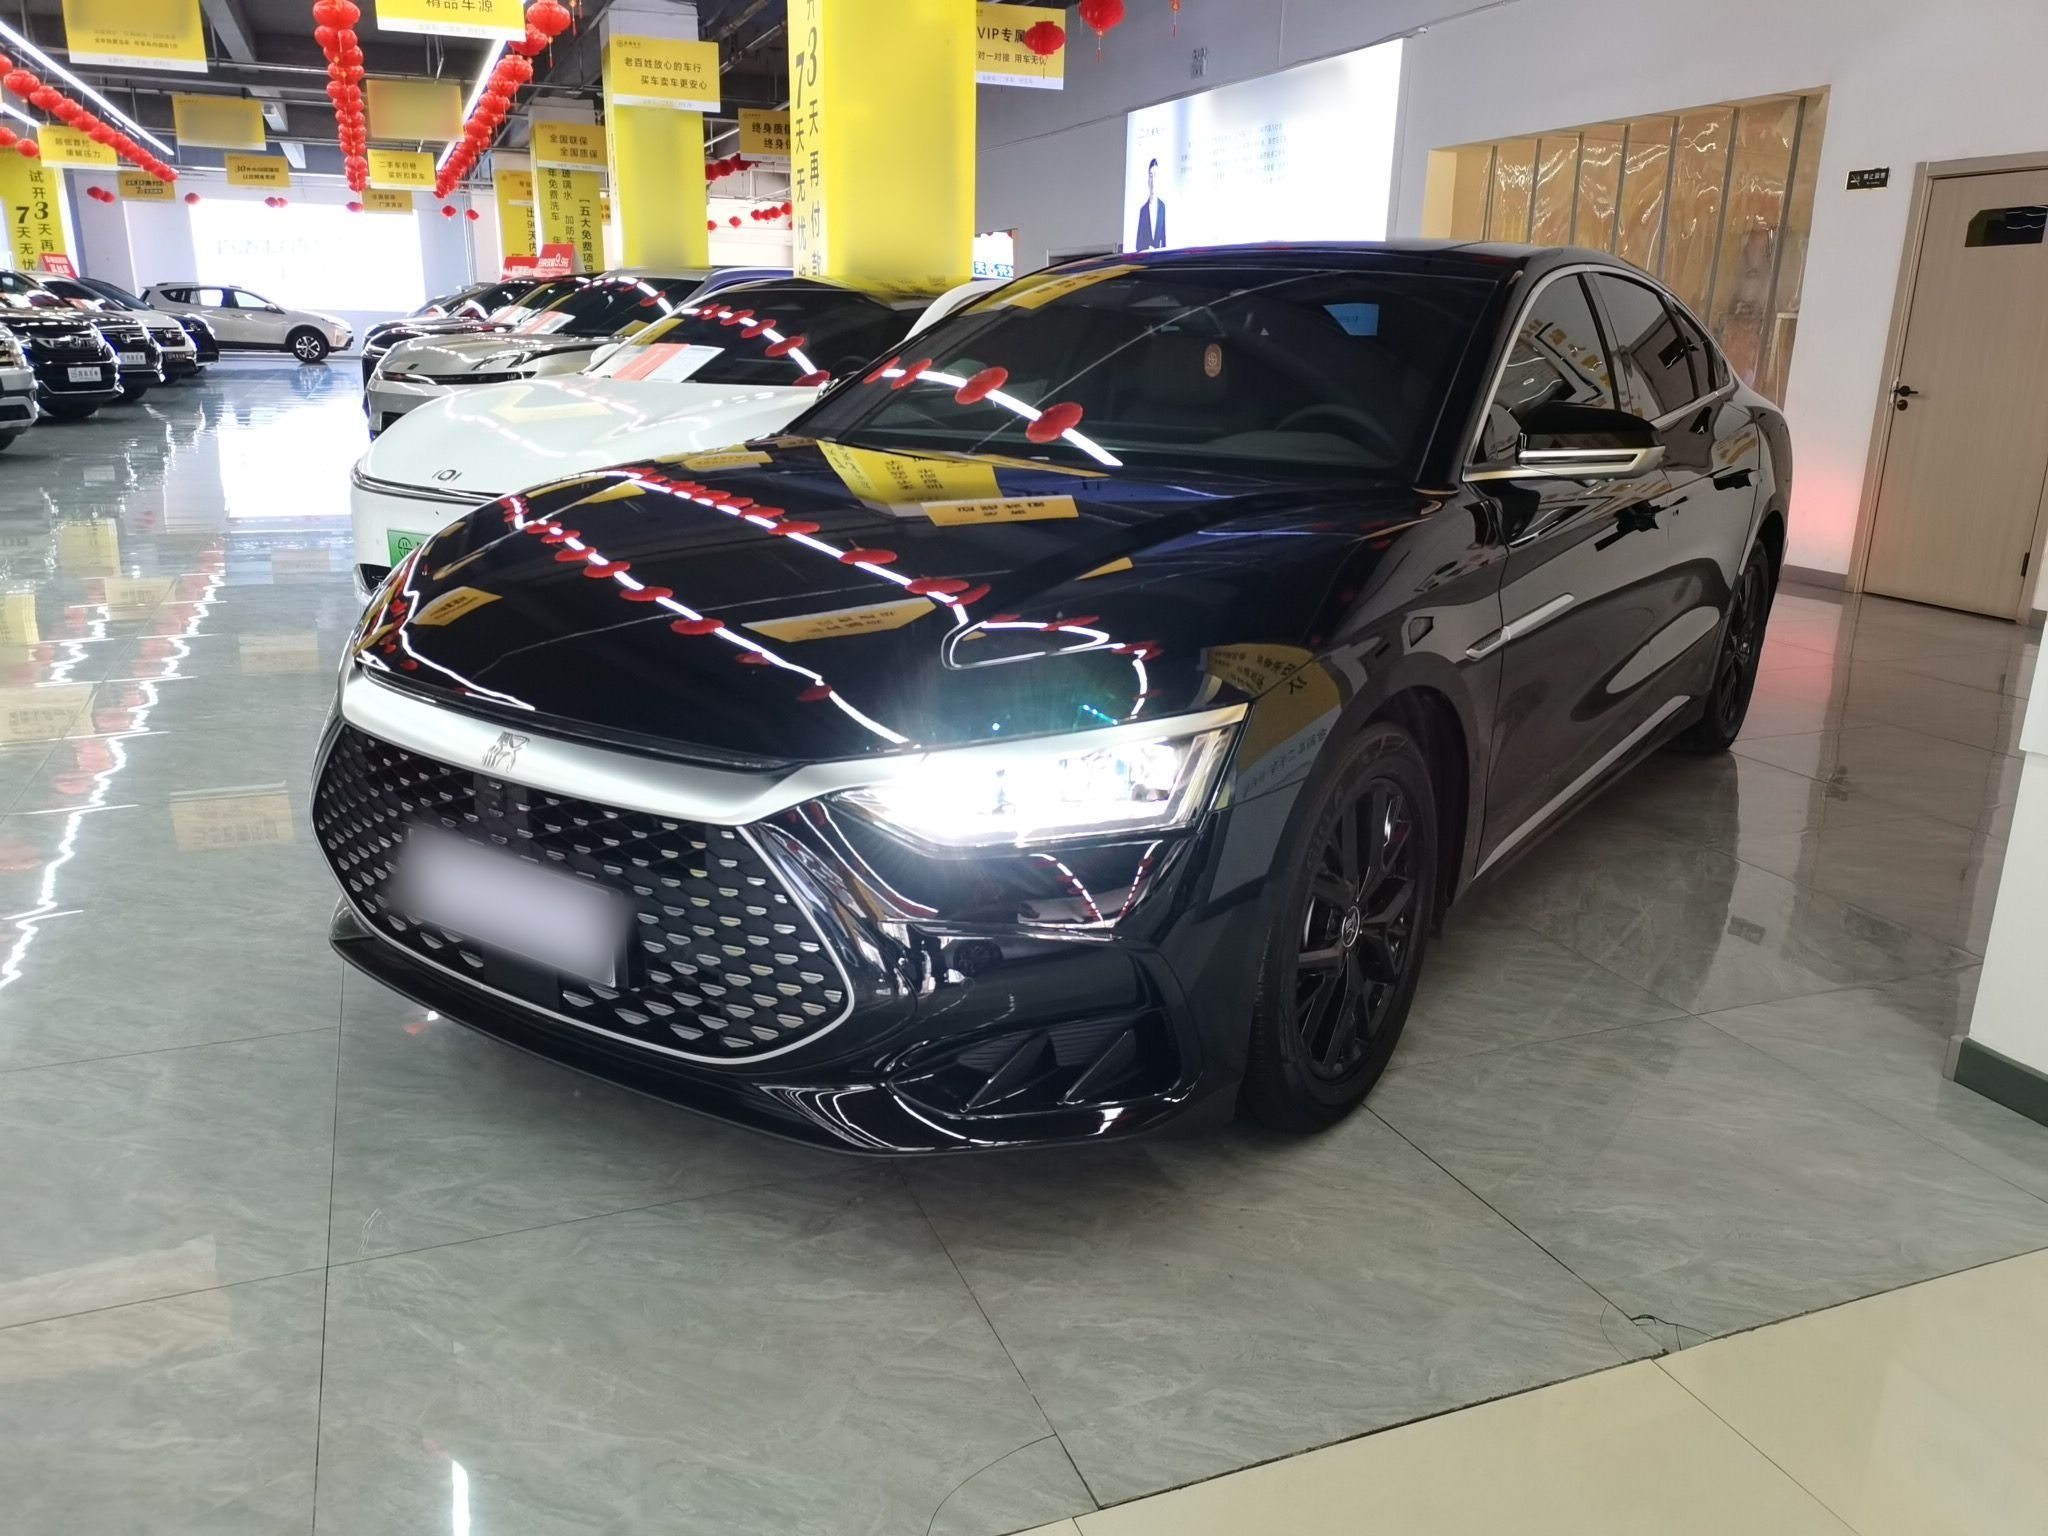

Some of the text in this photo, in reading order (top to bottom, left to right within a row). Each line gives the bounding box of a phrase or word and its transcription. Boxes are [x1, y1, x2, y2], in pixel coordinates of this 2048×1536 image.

[975, 51, 1010, 63] 对一对接
[624, 57, 702, 73] 老百姓放心的车行
[641, 75, 708, 90] 买车卖车更安心
[550, 134, 588, 146] 全国联保
